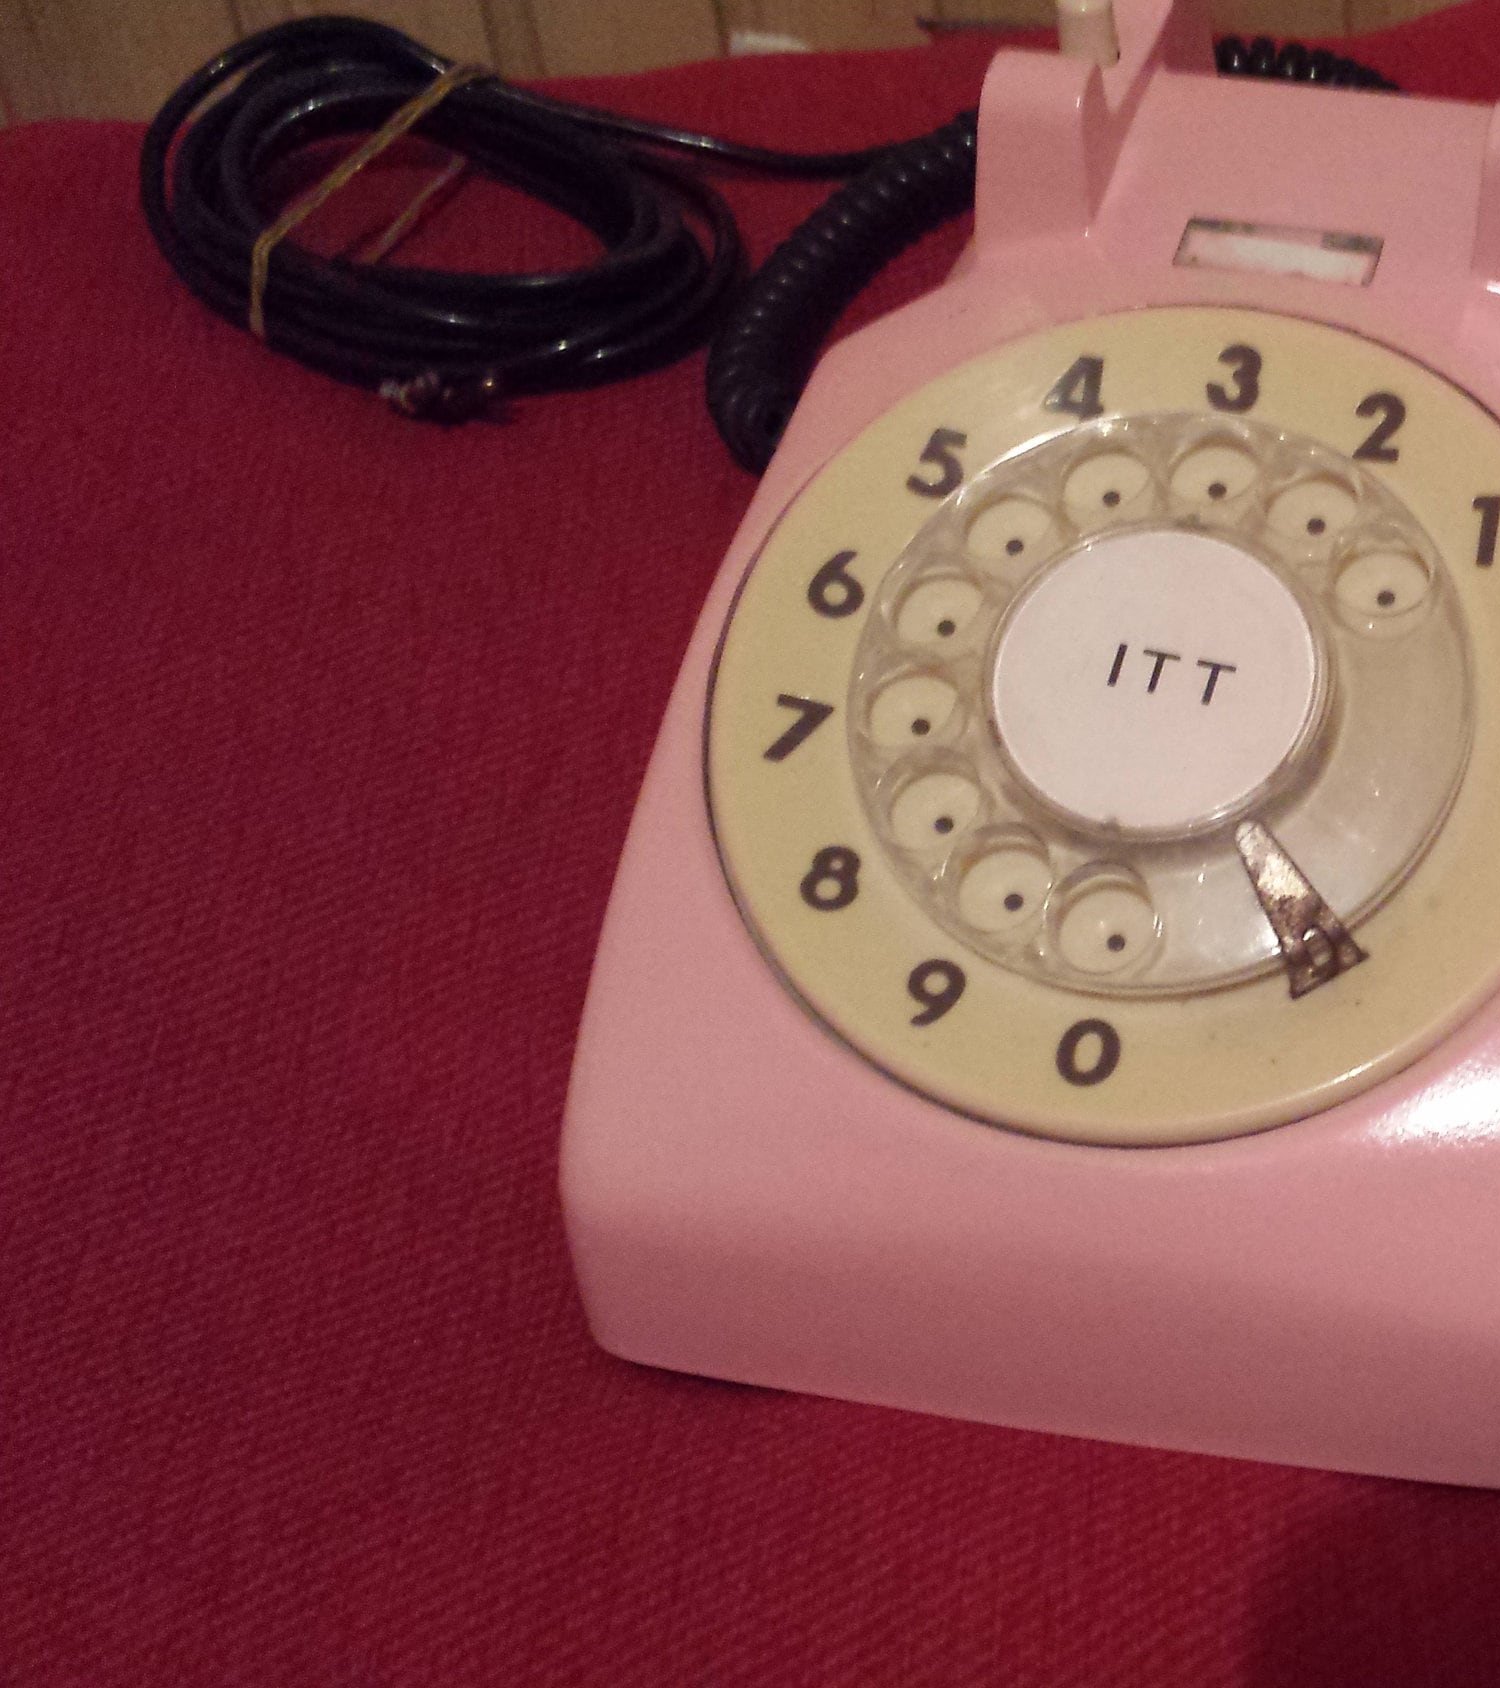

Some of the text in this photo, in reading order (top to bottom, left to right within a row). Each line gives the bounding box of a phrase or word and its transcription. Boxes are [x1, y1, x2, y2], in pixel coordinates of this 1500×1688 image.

[1044, 354, 1105, 421] 4
[1205, 343, 1263, 415] 3
[1352, 392, 1407, 464] 2
[905, 428, 968, 500] 5
[806, 550, 865, 620] 6
[1106, 643, 1237, 706] ITT
[763, 693, 835, 763] 7
[800, 846, 861, 912] 8
[907, 958, 967, 1027] 9
[1055, 1017, 1121, 1087] 0
